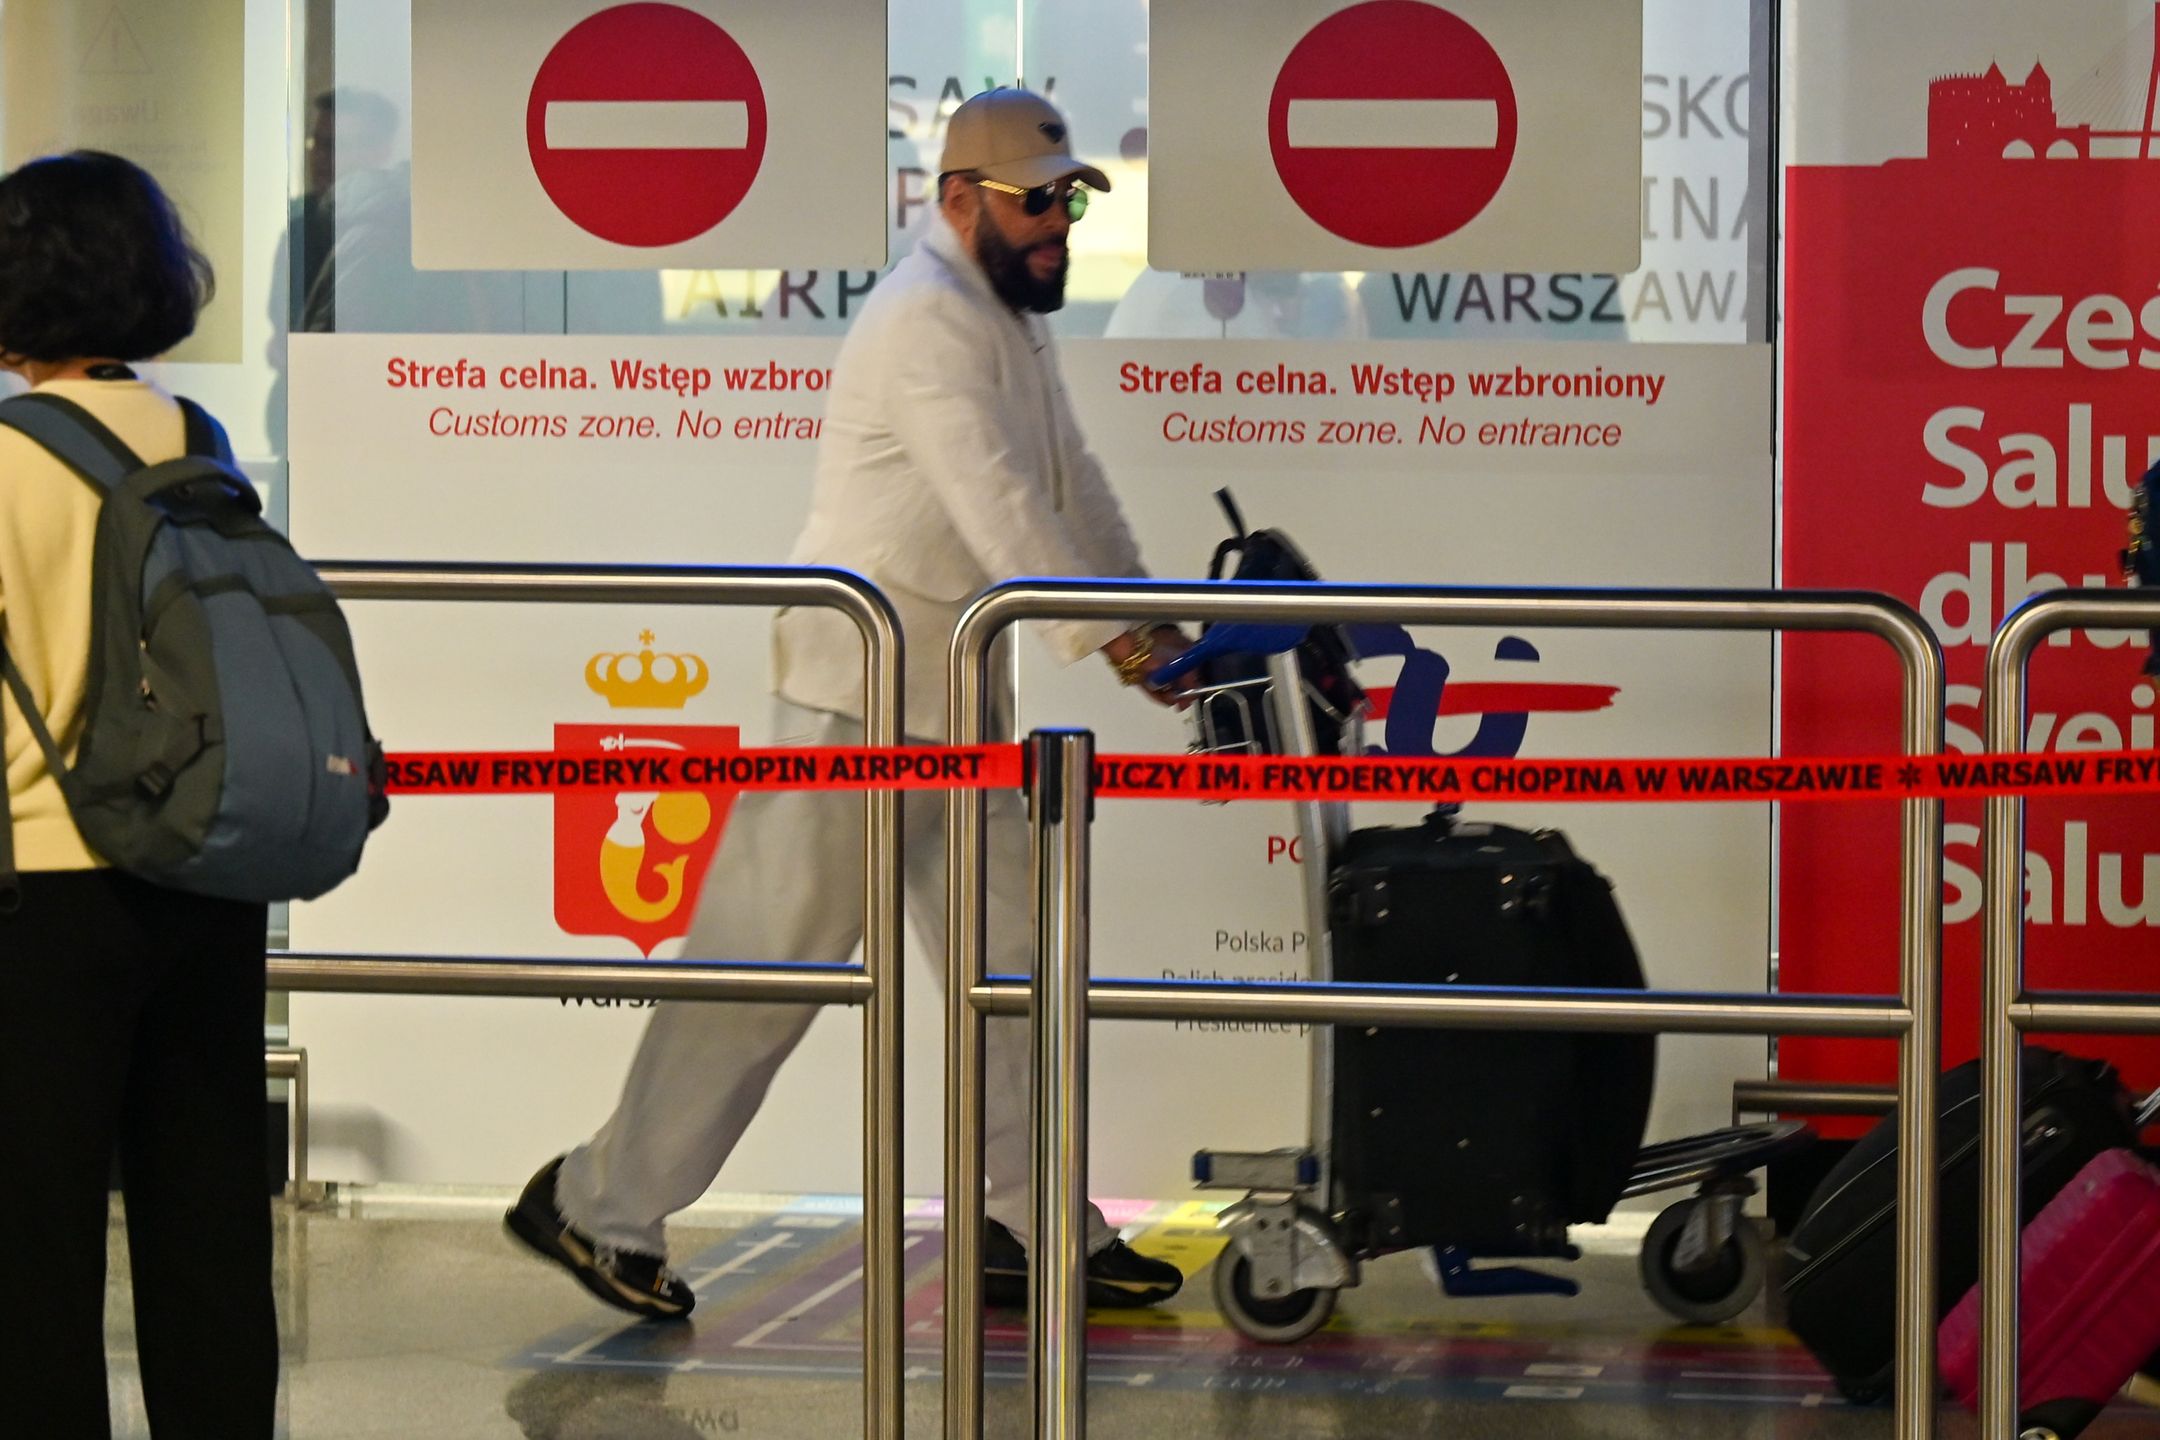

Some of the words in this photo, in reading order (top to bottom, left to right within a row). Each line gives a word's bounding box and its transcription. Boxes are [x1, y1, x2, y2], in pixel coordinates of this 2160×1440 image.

[1392, 271, 1748, 323] WARSZAW
[387, 358, 486, 389] Strefa
[499, 358, 597, 390] celna.
[610, 359, 711, 397] Wstęp
[1119, 362, 1222, 393] Strefa
[1236, 363, 1336, 395] celna.
[1351, 364, 1455, 402] Wstęp
[1468, 365, 1665, 405] wzbroniony
[429, 407, 567, 437] Customs
[578, 414, 661, 439] zone.
[676, 409, 721, 439] No
[1162, 412, 1306, 444] Customs
[1317, 421, 1402, 444] zone.
[1418, 415, 1466, 444] No
[1478, 418, 1622, 446] entrance
[492, 757, 671, 786] FRYDERYK
[681, 755, 817, 783] CHOPIN
[828, 752, 985, 781] AIRPORT
[1199, 763, 1249, 789] IM.
[1263, 764, 1460, 792] FRYDERYKA
[1473, 764, 1624, 792] CHOPINA
[1635, 767, 1667, 792] W
[1678, 764, 1882, 792] WARSZAWIE
[1937, 758, 2086, 788] WARSAW
[2098, 757, 2160, 783] FRY
[1216, 930, 1283, 952] Polska
